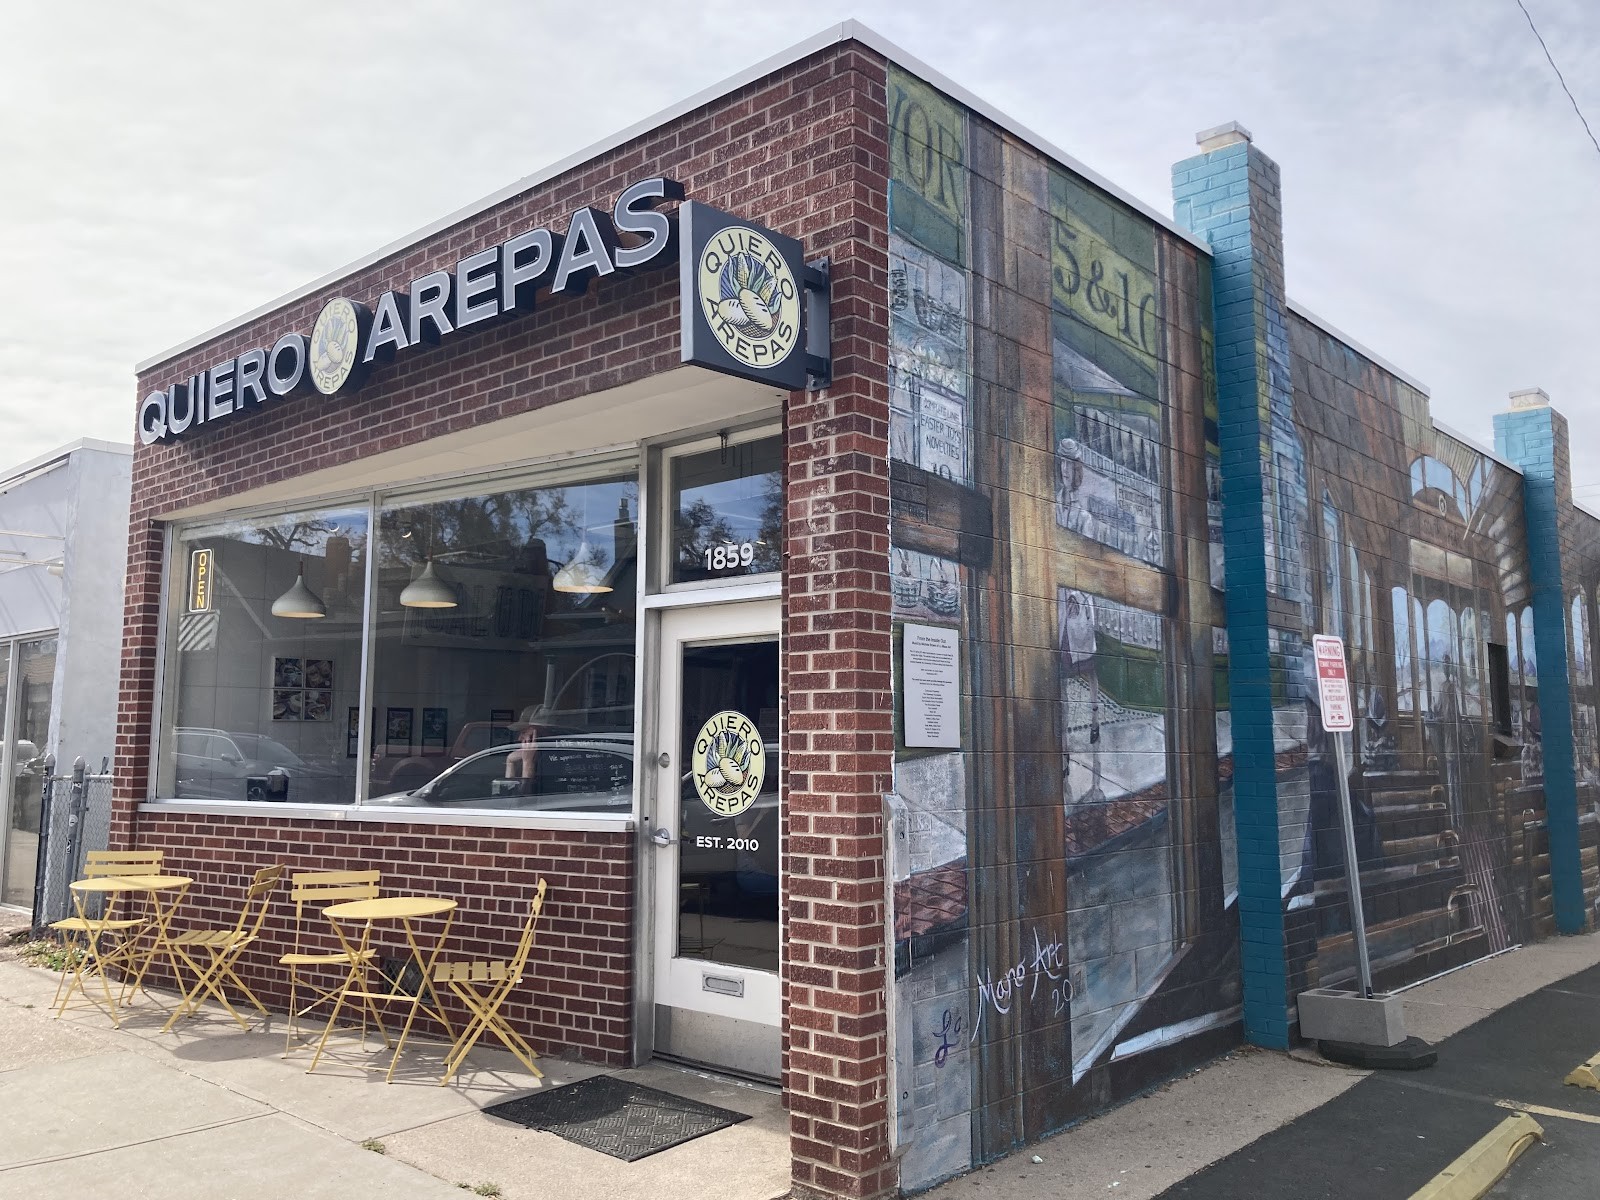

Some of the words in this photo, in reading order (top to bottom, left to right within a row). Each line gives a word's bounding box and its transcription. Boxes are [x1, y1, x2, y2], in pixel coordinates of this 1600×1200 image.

[705, 233, 794, 300] QUIERO
[138, 332, 306, 445] QUIERO
[362, 177, 670, 364] AREPAS
[313, 303, 356, 343] QUIERO
[706, 297, 792, 362] AREPAS
[312, 350, 353, 389] AREPAS
[920, 413, 944, 434] EASTER
[946, 424, 962, 443] TOYS
[925, 434, 960, 460] NOVELTIES
[704, 543, 754, 571] 1859
[196, 553, 208, 609] OPEN
[697, 715, 761, 756] QUIERO
[697, 773, 758, 812] AREPAS
[696, 836, 724, 849] EST.
[726, 838, 759, 851] 2010
